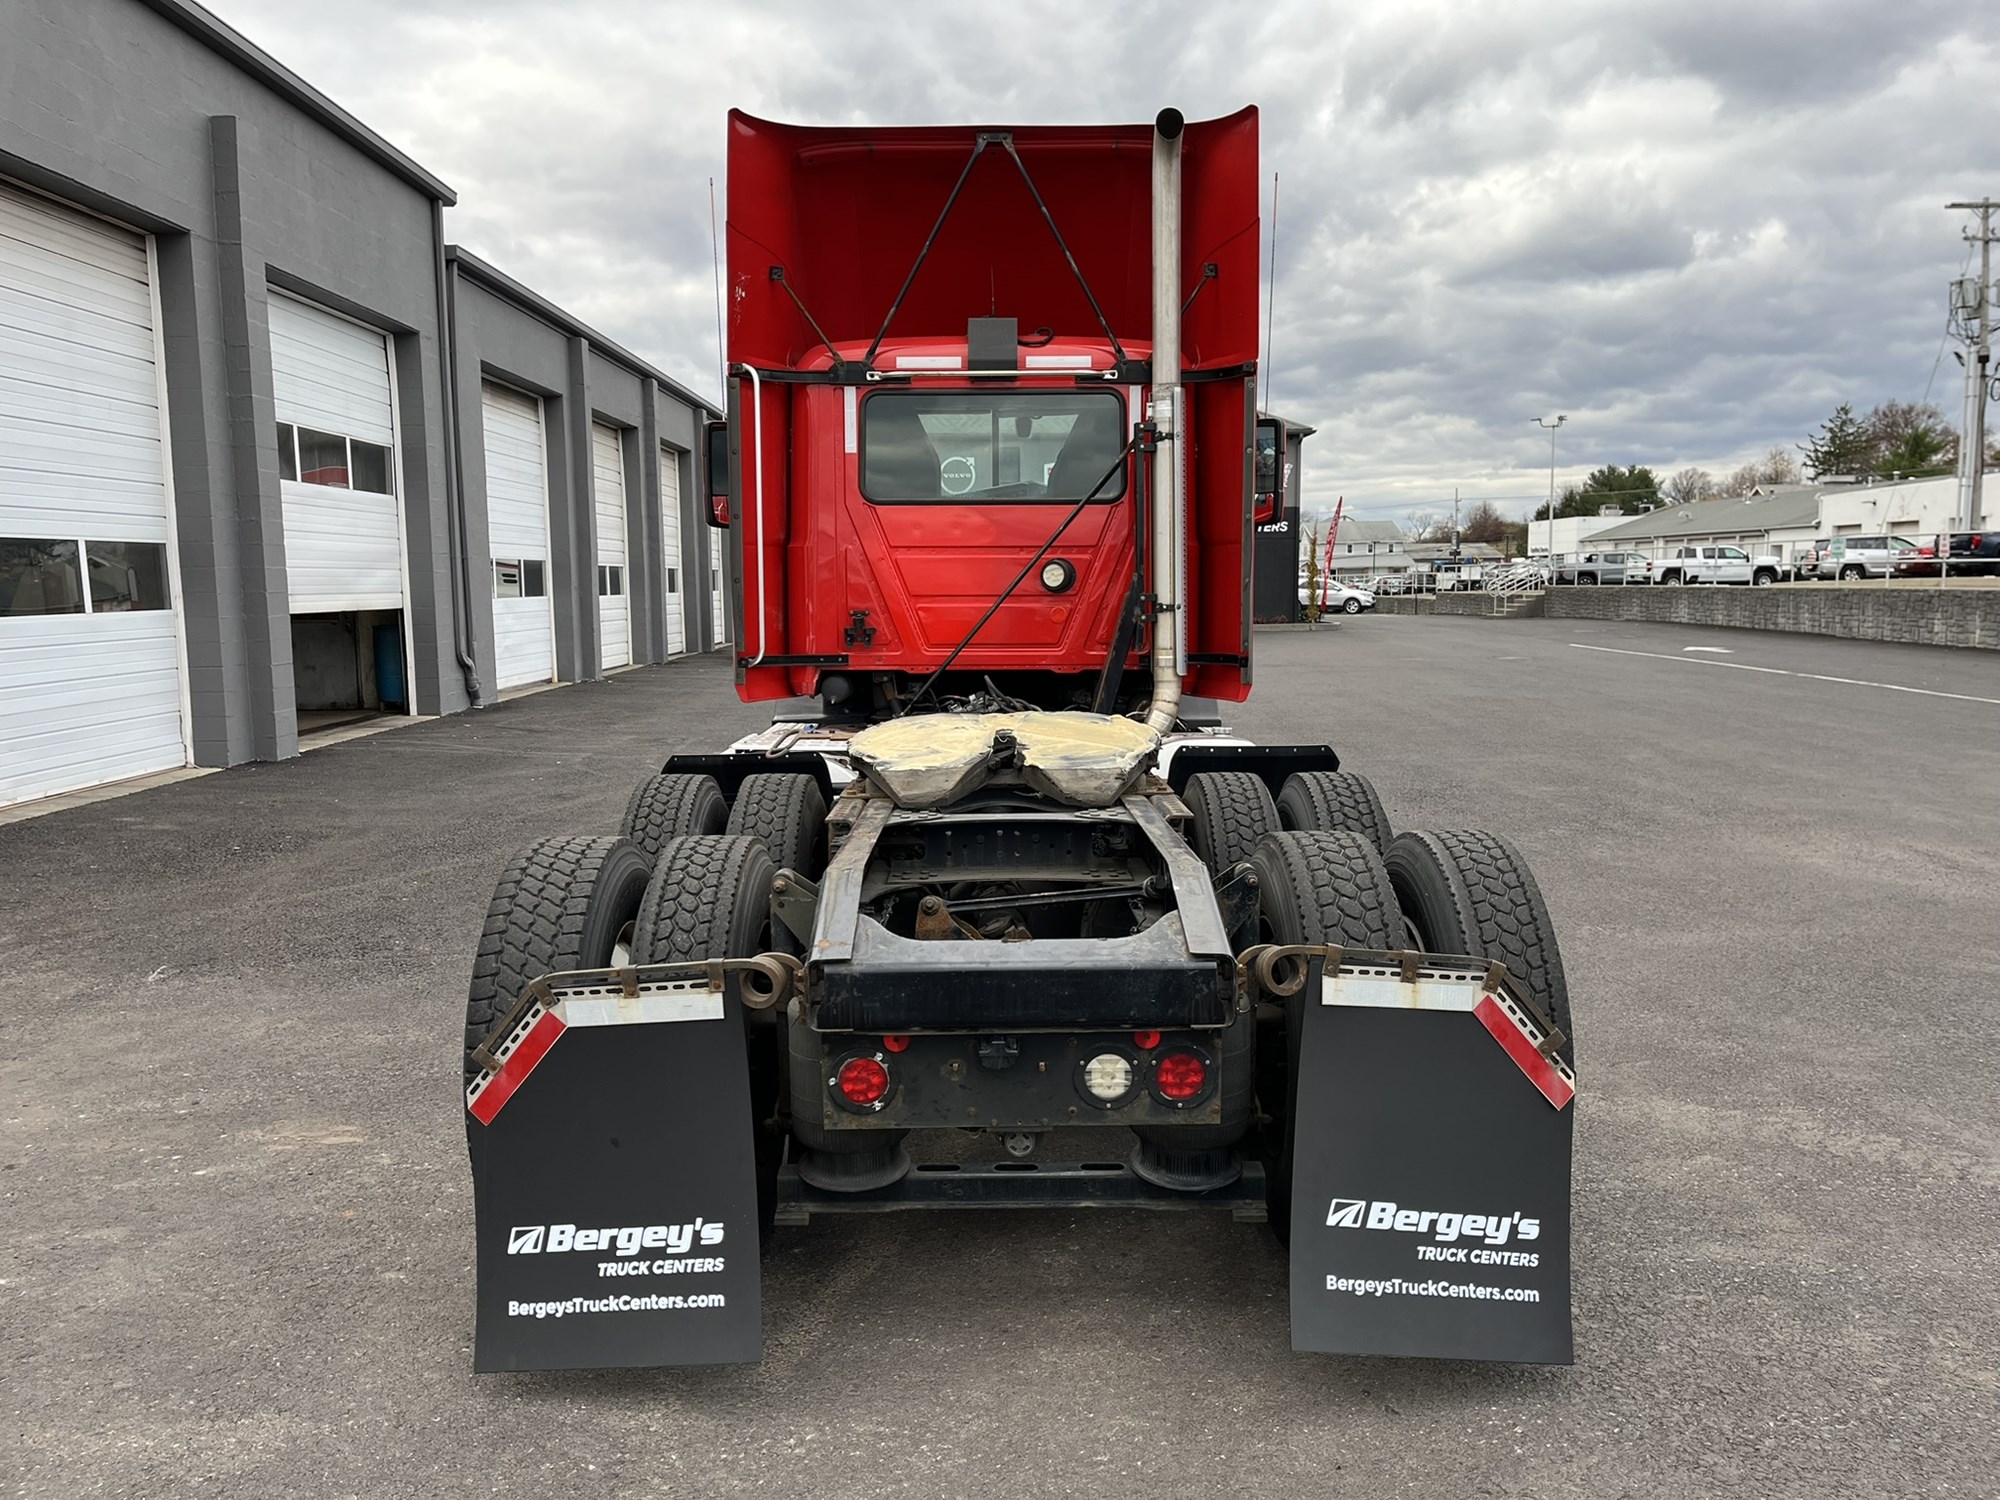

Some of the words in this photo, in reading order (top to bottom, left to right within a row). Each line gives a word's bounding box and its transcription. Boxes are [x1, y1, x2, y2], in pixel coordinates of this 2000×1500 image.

[1366, 1202, 1539, 1245] Bergey's
[547, 1217, 724, 1256] Bergey's
[598, 1261, 651, 1277] TRUCK
[652, 1257, 724, 1274] CENTERS
[1417, 1246, 1467, 1262] TRUCK
[1470, 1250, 1539, 1267] CENTERS
[1326, 1275, 1539, 1302] BergeysTruckCenters.com
[509, 1294, 725, 1317] BergeysTruckCenters.com
